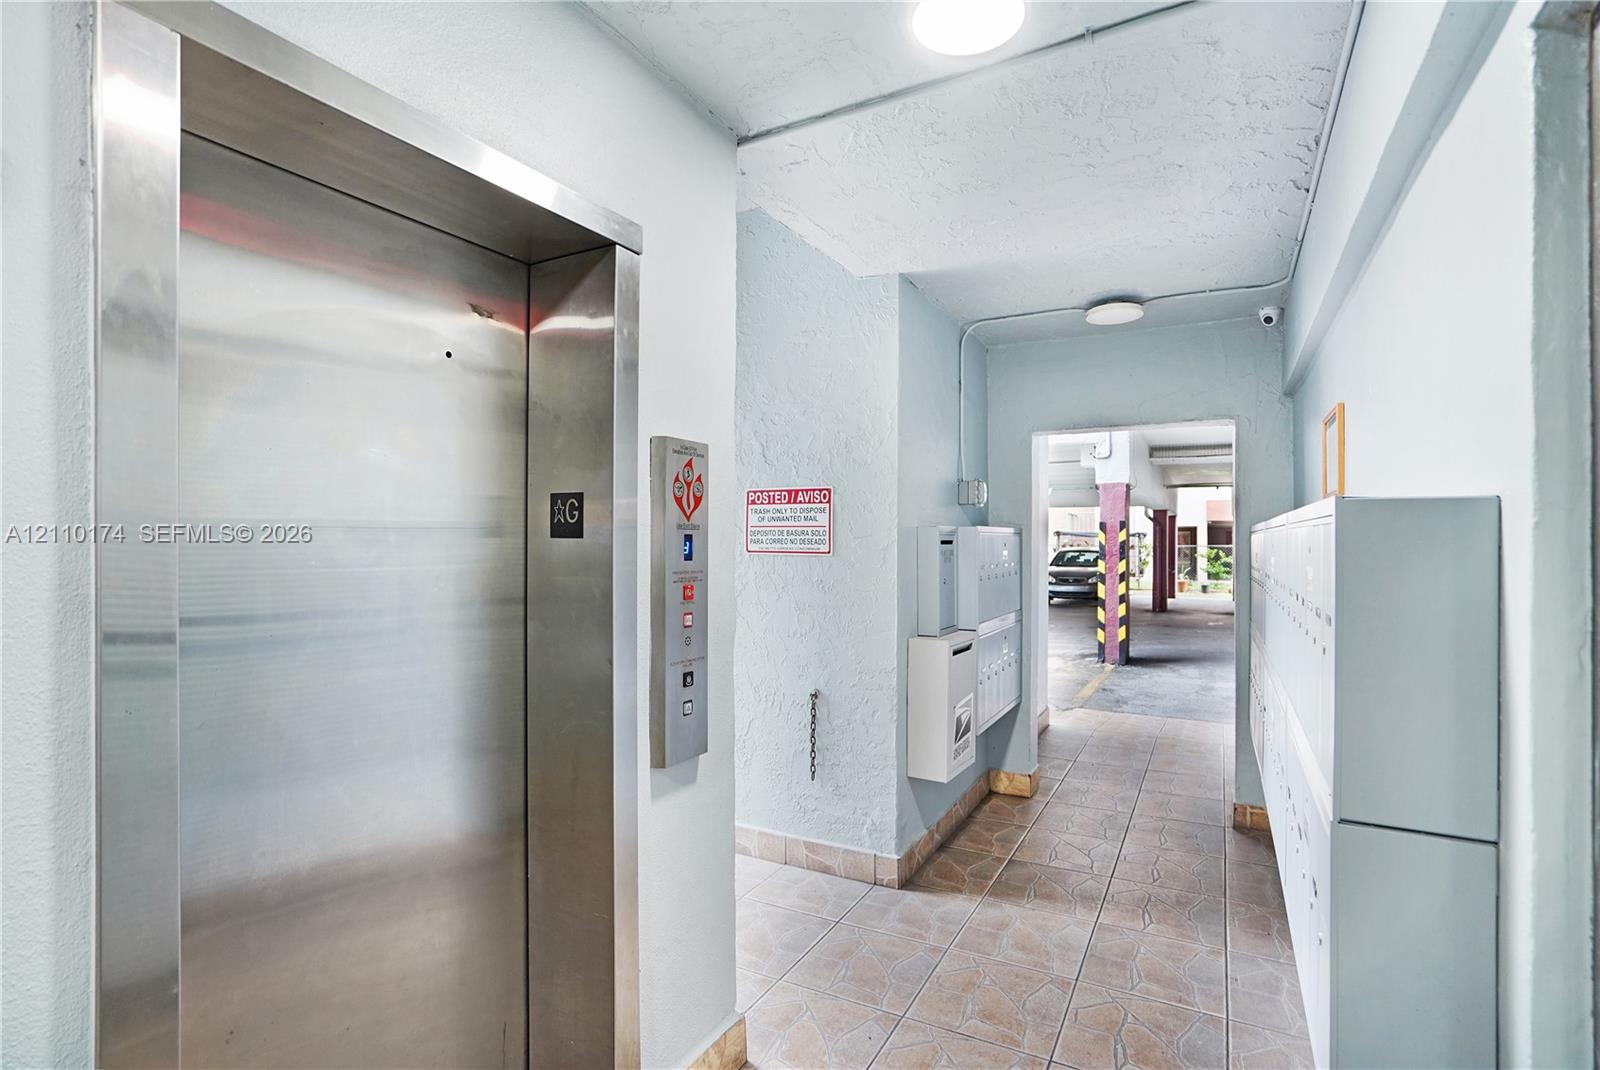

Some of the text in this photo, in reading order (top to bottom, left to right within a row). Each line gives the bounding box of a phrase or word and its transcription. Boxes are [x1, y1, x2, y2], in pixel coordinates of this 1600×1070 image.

[748, 490, 829, 504] POSTED / AVISO
[750, 507, 770, 515] TRASH
[772, 507, 787, 515] ONLY
[799, 506, 827, 514] DISPOSE
[757, 515, 766, 523] OF
[750, 529, 827, 537] DEPOSITO DE BASURA SOLO
[799, 538, 827, 546] DESEADO
